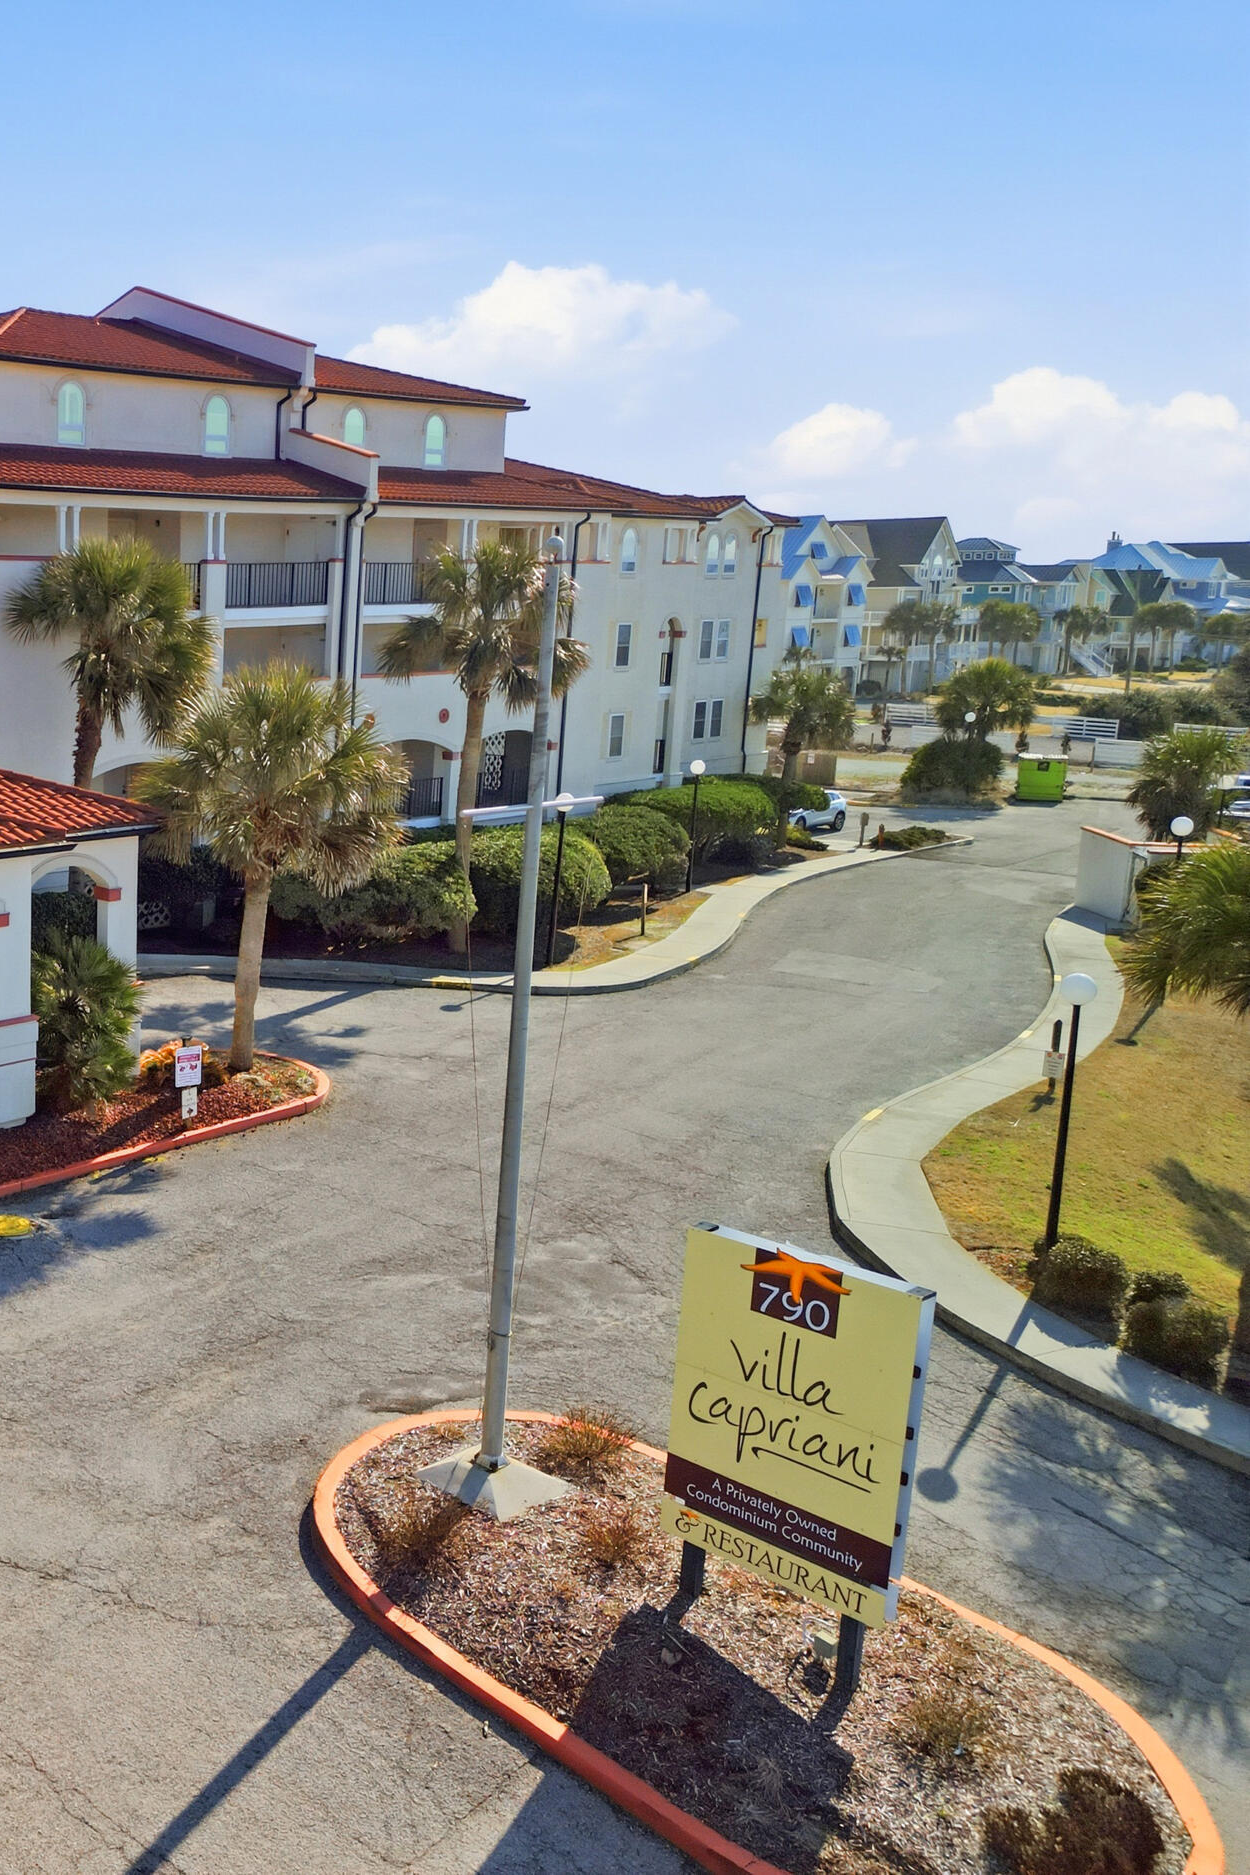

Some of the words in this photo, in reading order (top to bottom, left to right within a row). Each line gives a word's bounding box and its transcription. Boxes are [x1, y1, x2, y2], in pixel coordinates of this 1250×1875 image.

[758, 1282, 831, 1332] 790
[688, 1381, 881, 1484] Capriani
[686, 1483, 778, 1534] Condominium
[781, 1525, 863, 1573] Community
[711, 1478, 722, 1491] A
[726, 1483, 782, 1520] Privately
[786, 1509, 837, 1541] Owned
[674, 1511, 701, 1534] &
[703, 1522, 868, 1615] RESTAURANT
